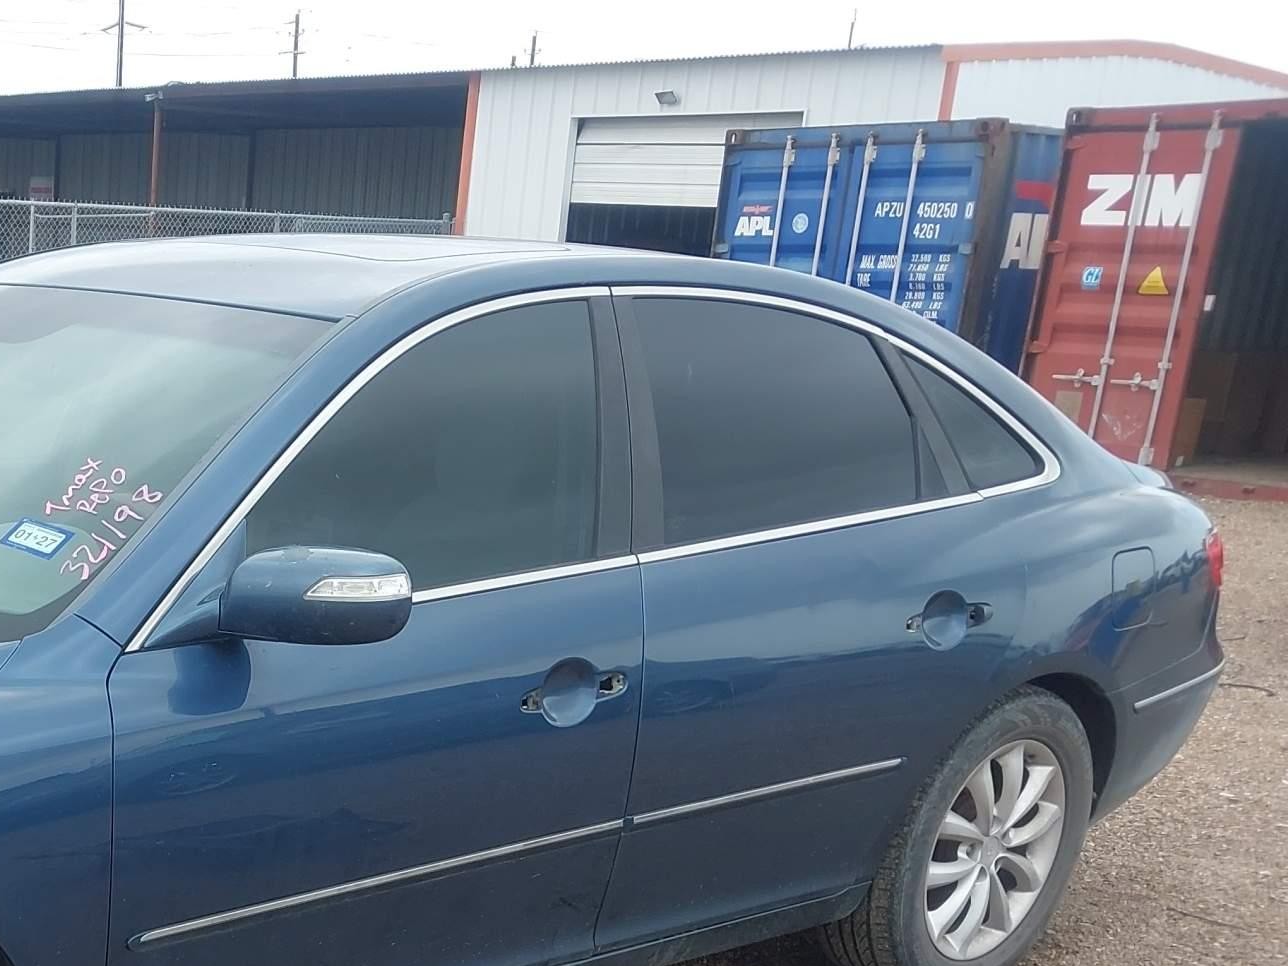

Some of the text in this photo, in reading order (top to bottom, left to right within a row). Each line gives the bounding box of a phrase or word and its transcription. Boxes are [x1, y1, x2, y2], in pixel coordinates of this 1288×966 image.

[1081, 174, 1205, 227] ZIM
[875, 202, 904, 217] APZU
[917, 202, 958, 218] 450250
[734, 216, 774, 236] APL
[913, 223, 941, 239] 42G1
[877, 254, 898, 269] GROSS
[857, 273, 871, 287] TARE
[60, 484, 163, 580] 321198
